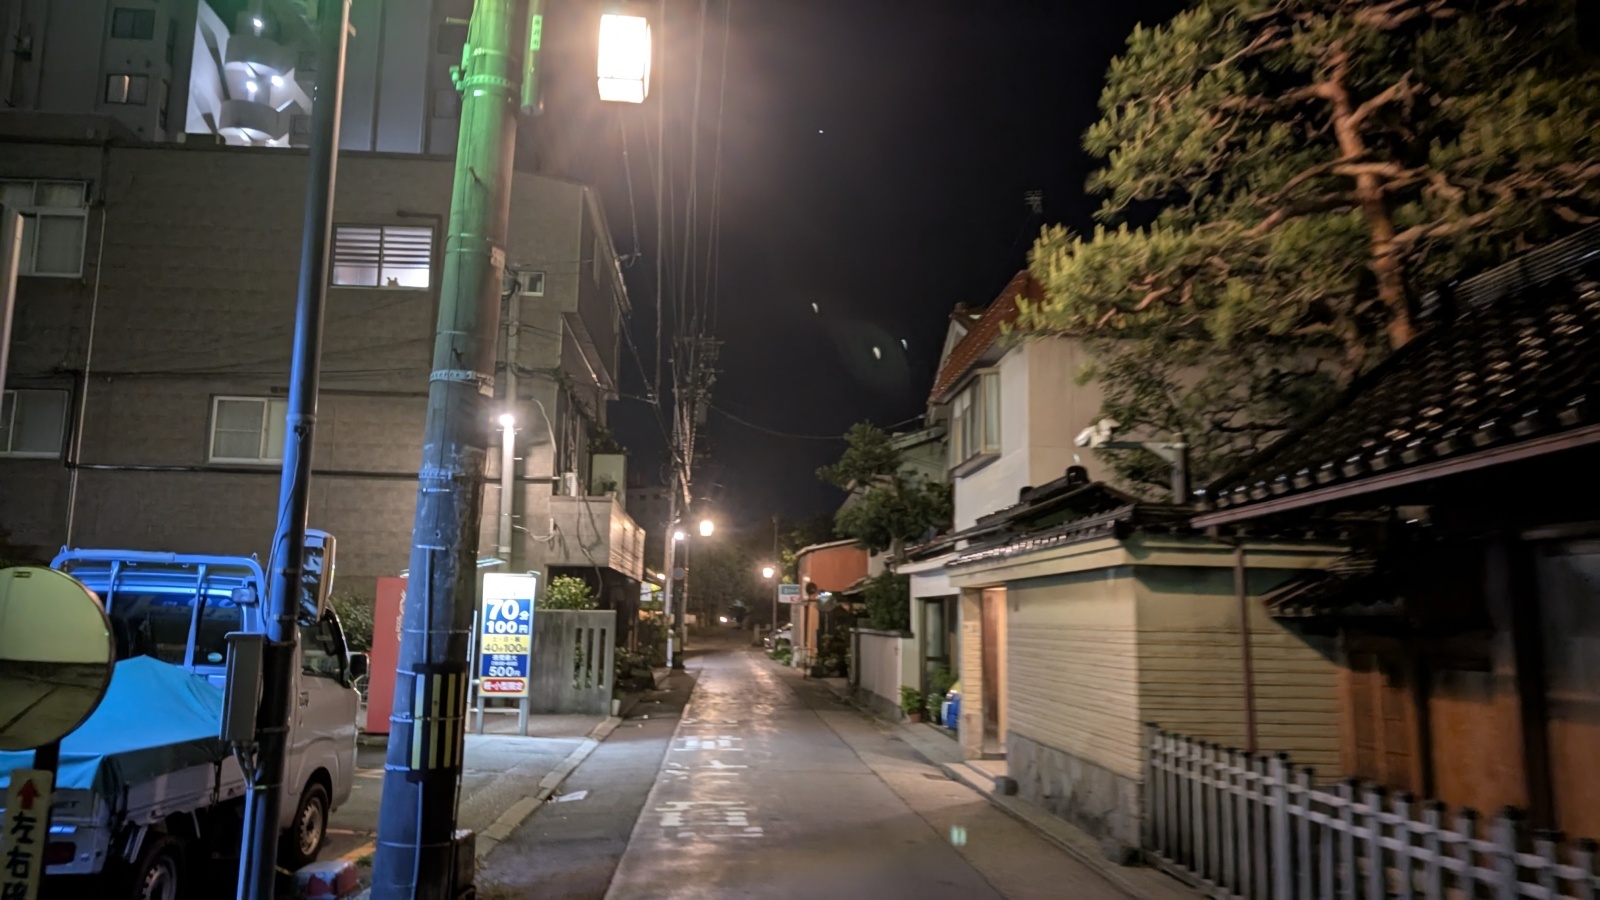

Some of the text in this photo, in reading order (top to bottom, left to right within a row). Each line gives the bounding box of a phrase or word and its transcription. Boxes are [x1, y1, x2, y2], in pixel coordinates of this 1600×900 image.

[487, 599, 530, 621] 70分
[486, 620, 529, 634] 100円
[489, 666, 521, 677] 500円
